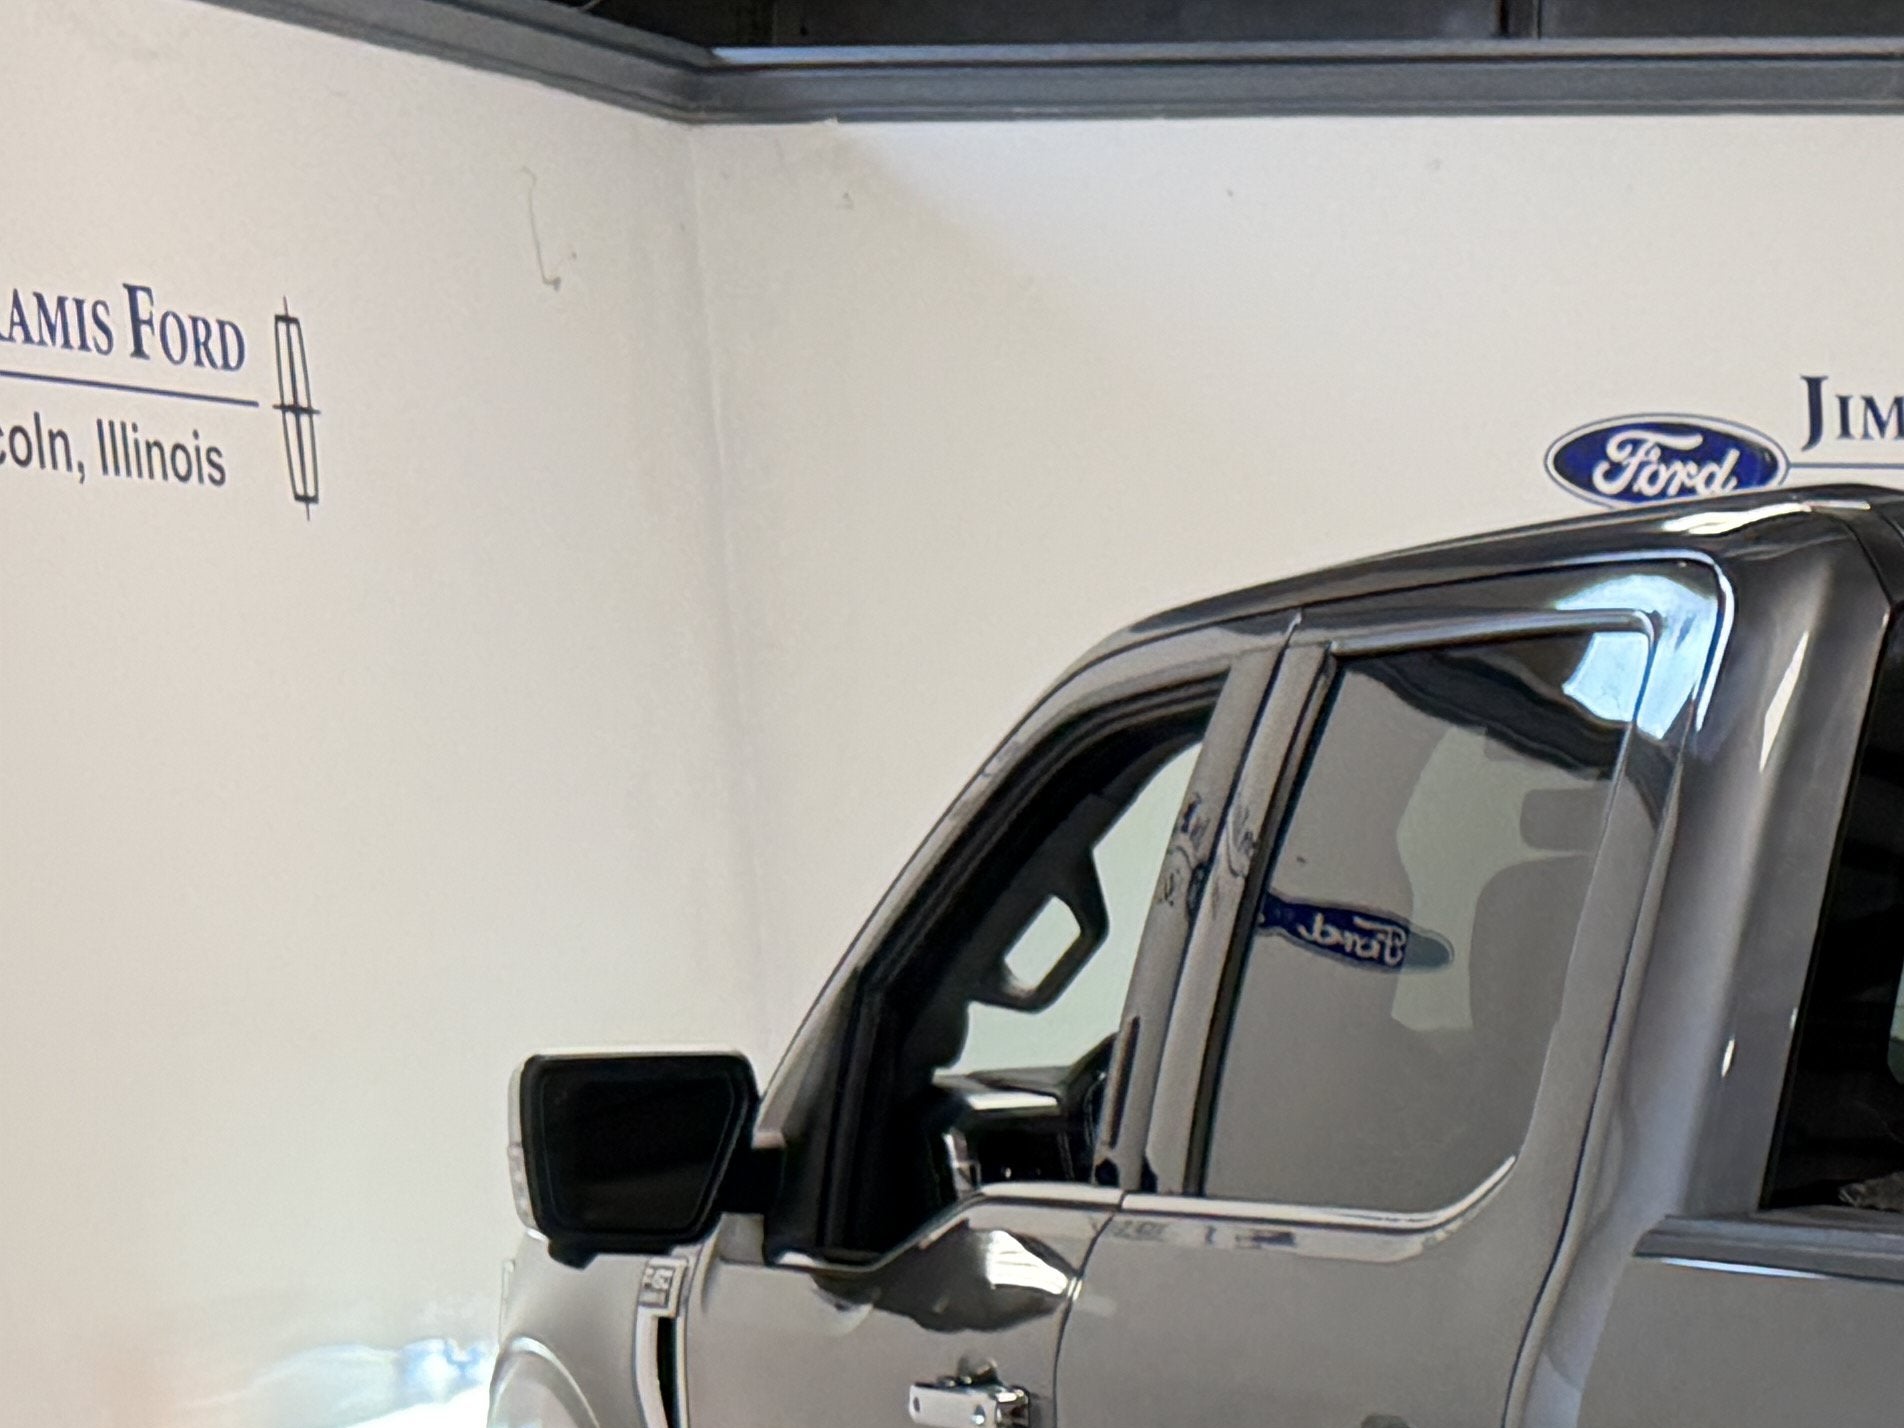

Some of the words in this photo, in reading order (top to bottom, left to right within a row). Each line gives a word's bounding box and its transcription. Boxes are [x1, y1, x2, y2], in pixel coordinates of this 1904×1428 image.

[0, 287, 114, 356] AMIS
[122, 282, 246, 372] FORD
[96, 417, 227, 487] Illinois
[1592, 429, 1740, 497] Ford
